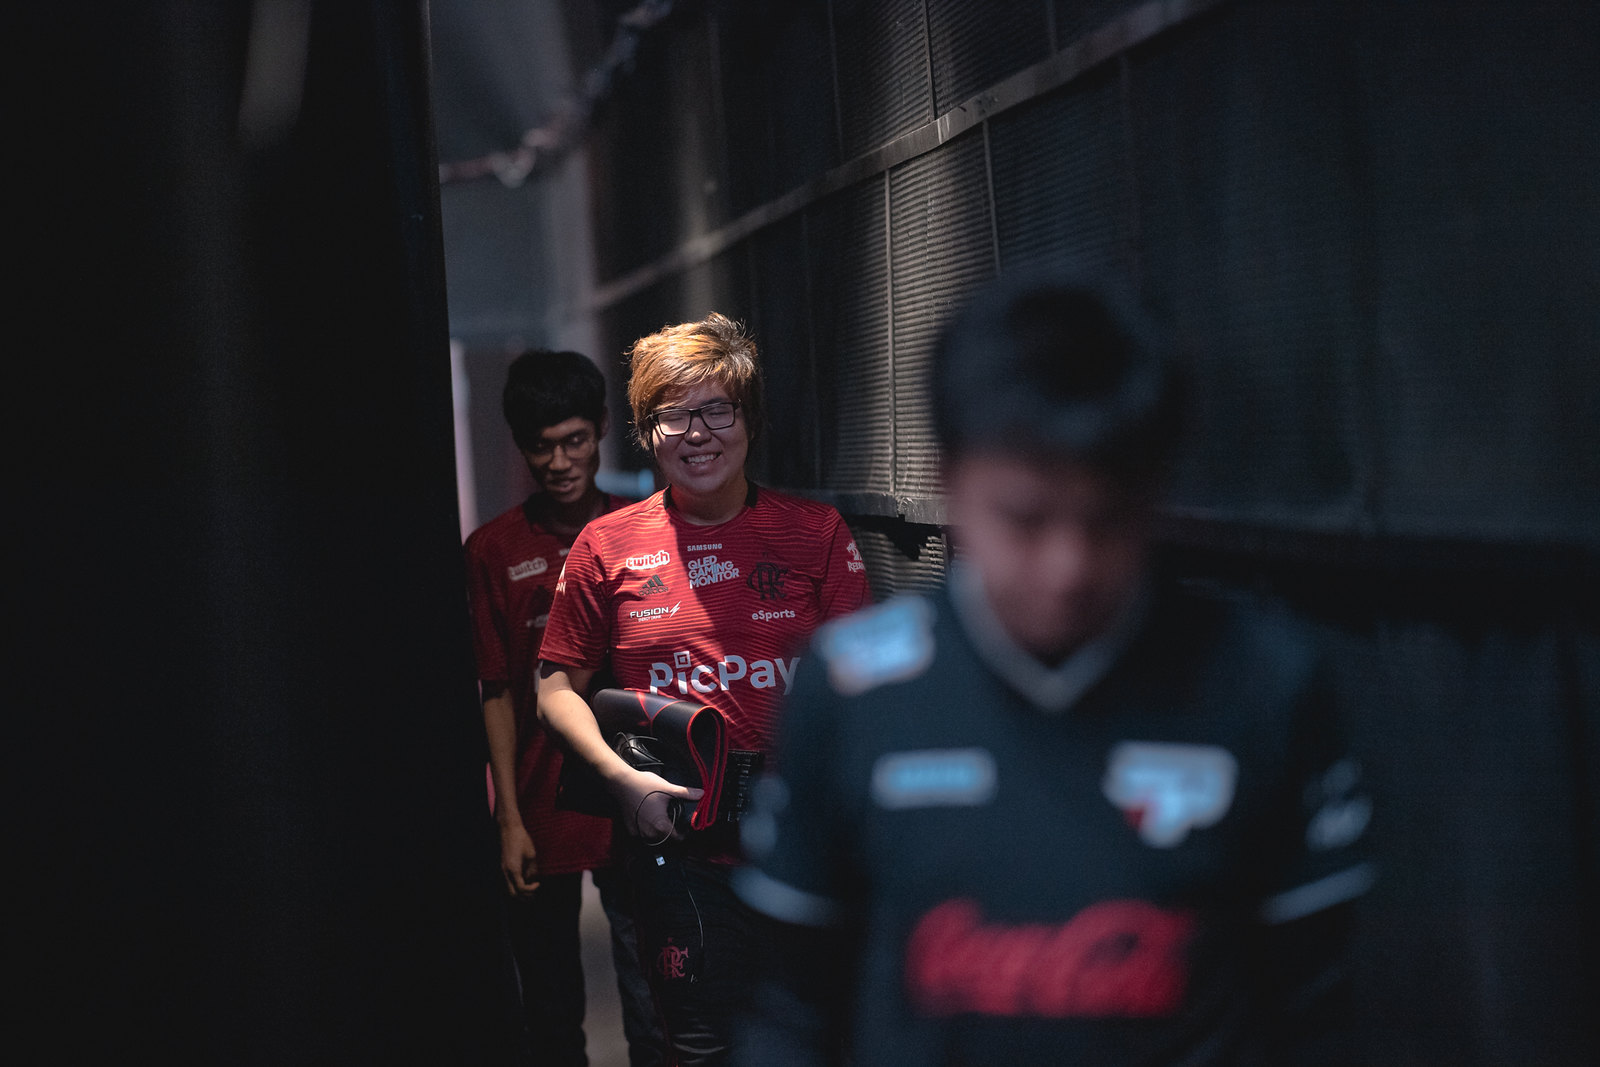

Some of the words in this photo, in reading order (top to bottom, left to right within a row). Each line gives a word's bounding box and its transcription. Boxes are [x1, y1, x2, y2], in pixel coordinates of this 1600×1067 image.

[687, 543, 723, 552] SAMSUNG
[627, 551, 669, 567] twitch
[688, 555, 718, 570] QLED
[688, 560, 734, 579] GAMING
[689, 568, 740, 590] MONITOR
[630, 606, 669, 618] FUSION
[751, 609, 796, 622] eSports
[648, 650, 801, 696] PicPay
